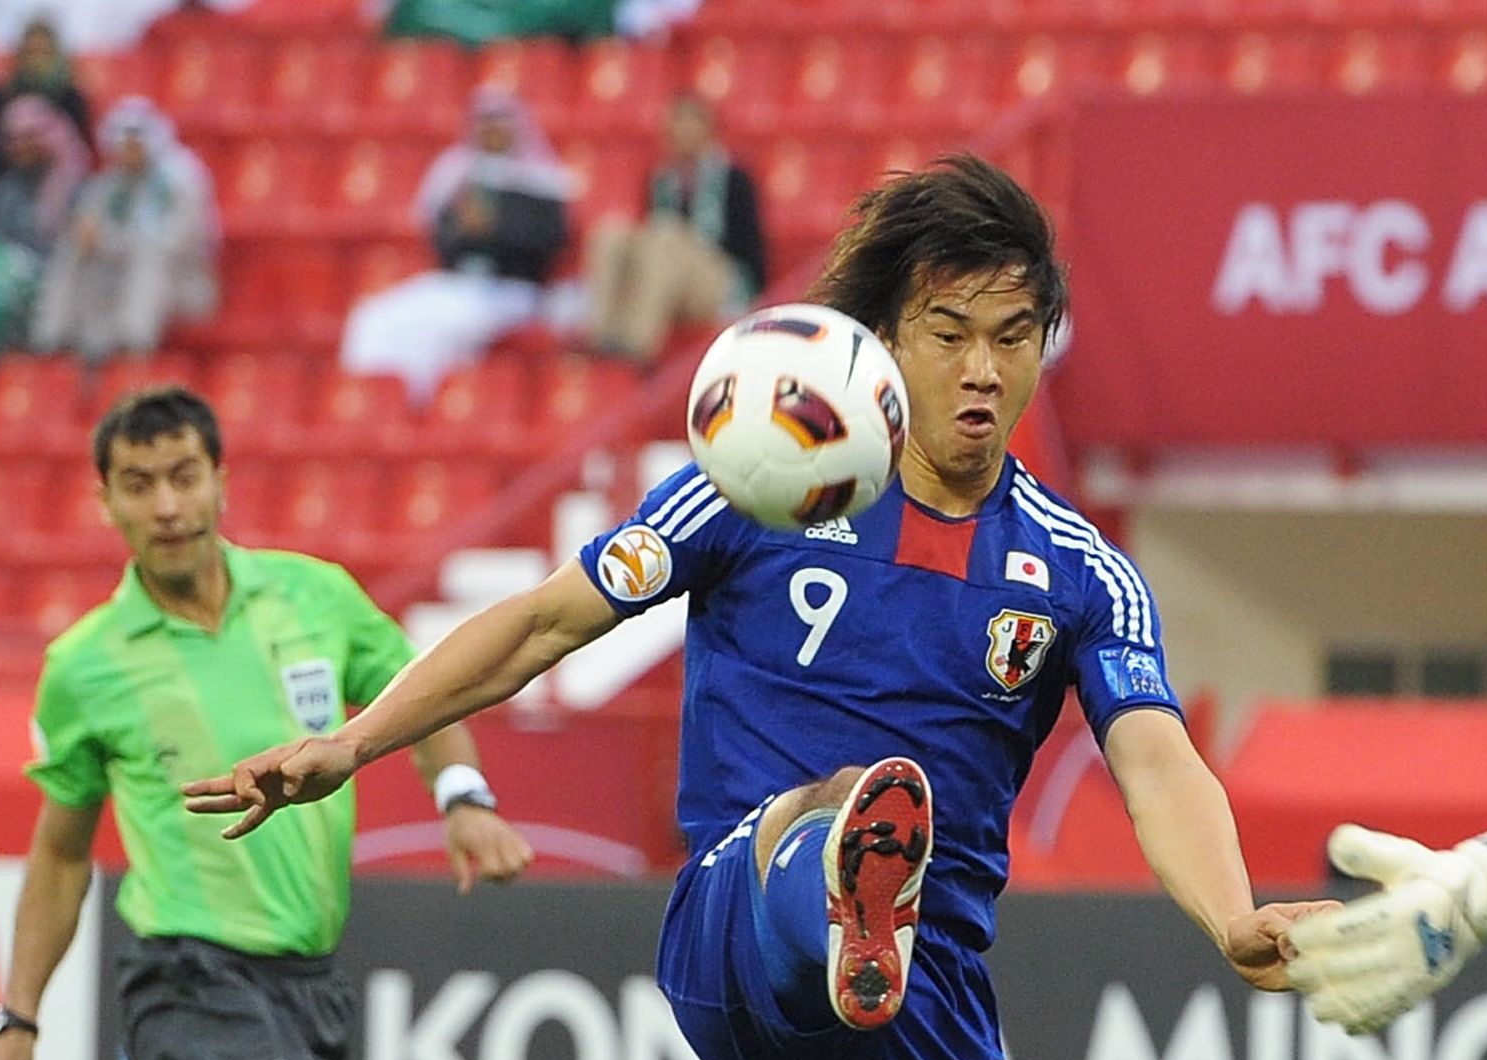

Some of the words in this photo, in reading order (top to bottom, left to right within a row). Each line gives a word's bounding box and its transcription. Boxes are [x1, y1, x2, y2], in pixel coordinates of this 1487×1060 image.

[1214, 200, 1431, 314] AFC
[789, 567, 849, 667] 9
[1002, 621, 1045, 639] JFA
